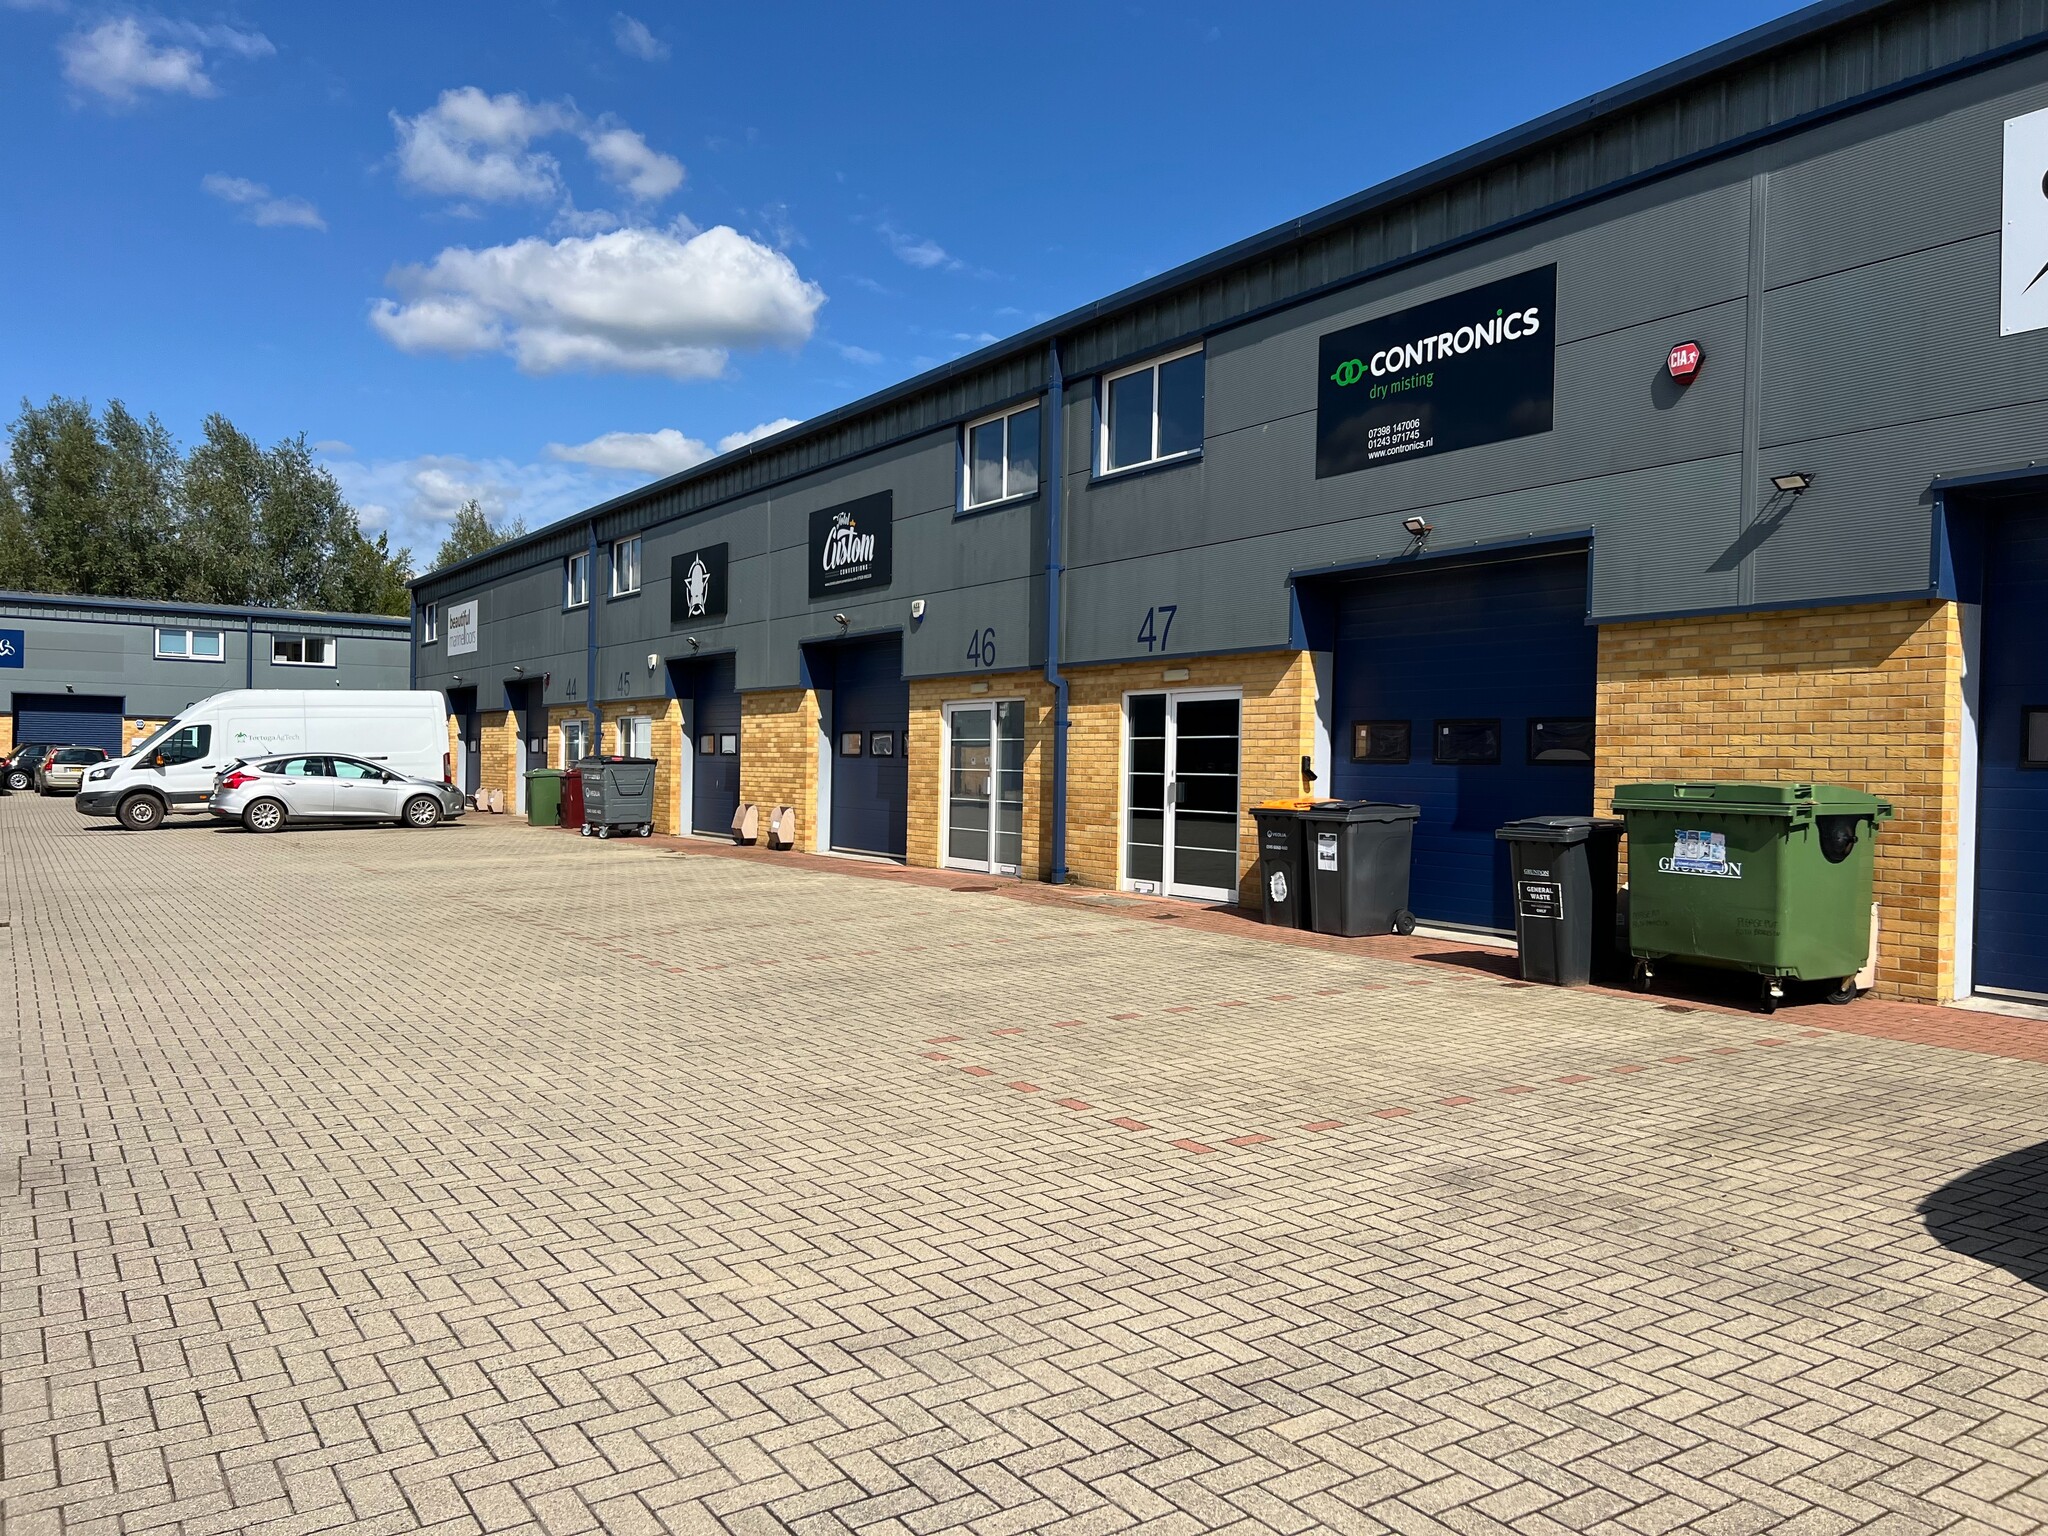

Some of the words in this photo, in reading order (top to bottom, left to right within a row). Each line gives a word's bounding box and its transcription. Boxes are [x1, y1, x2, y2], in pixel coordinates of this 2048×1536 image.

[1671, 350, 1687, 368] CIA
[1369, 384, 1388, 400] dry
[1390, 372, 1435, 394] misting
[1367, 436, 1391, 450] 01243
[1391, 429, 1420, 444] 971745
[1368, 425, 1391, 439] 07398
[1392, 418, 1420, 433] 147006
[1367, 436, 1434, 460] www.contronics.nl
[822, 526, 875, 571] Custom
[449, 608, 471, 630] beautiful
[1137, 604, 1178, 653] 47
[966, 627, 996, 668] 46
[565, 677, 577, 700] 44
[617, 671, 631, 697] 45
[1526, 886, 1554, 894] GENERAL
[1530, 893, 1551, 901] WASTE
